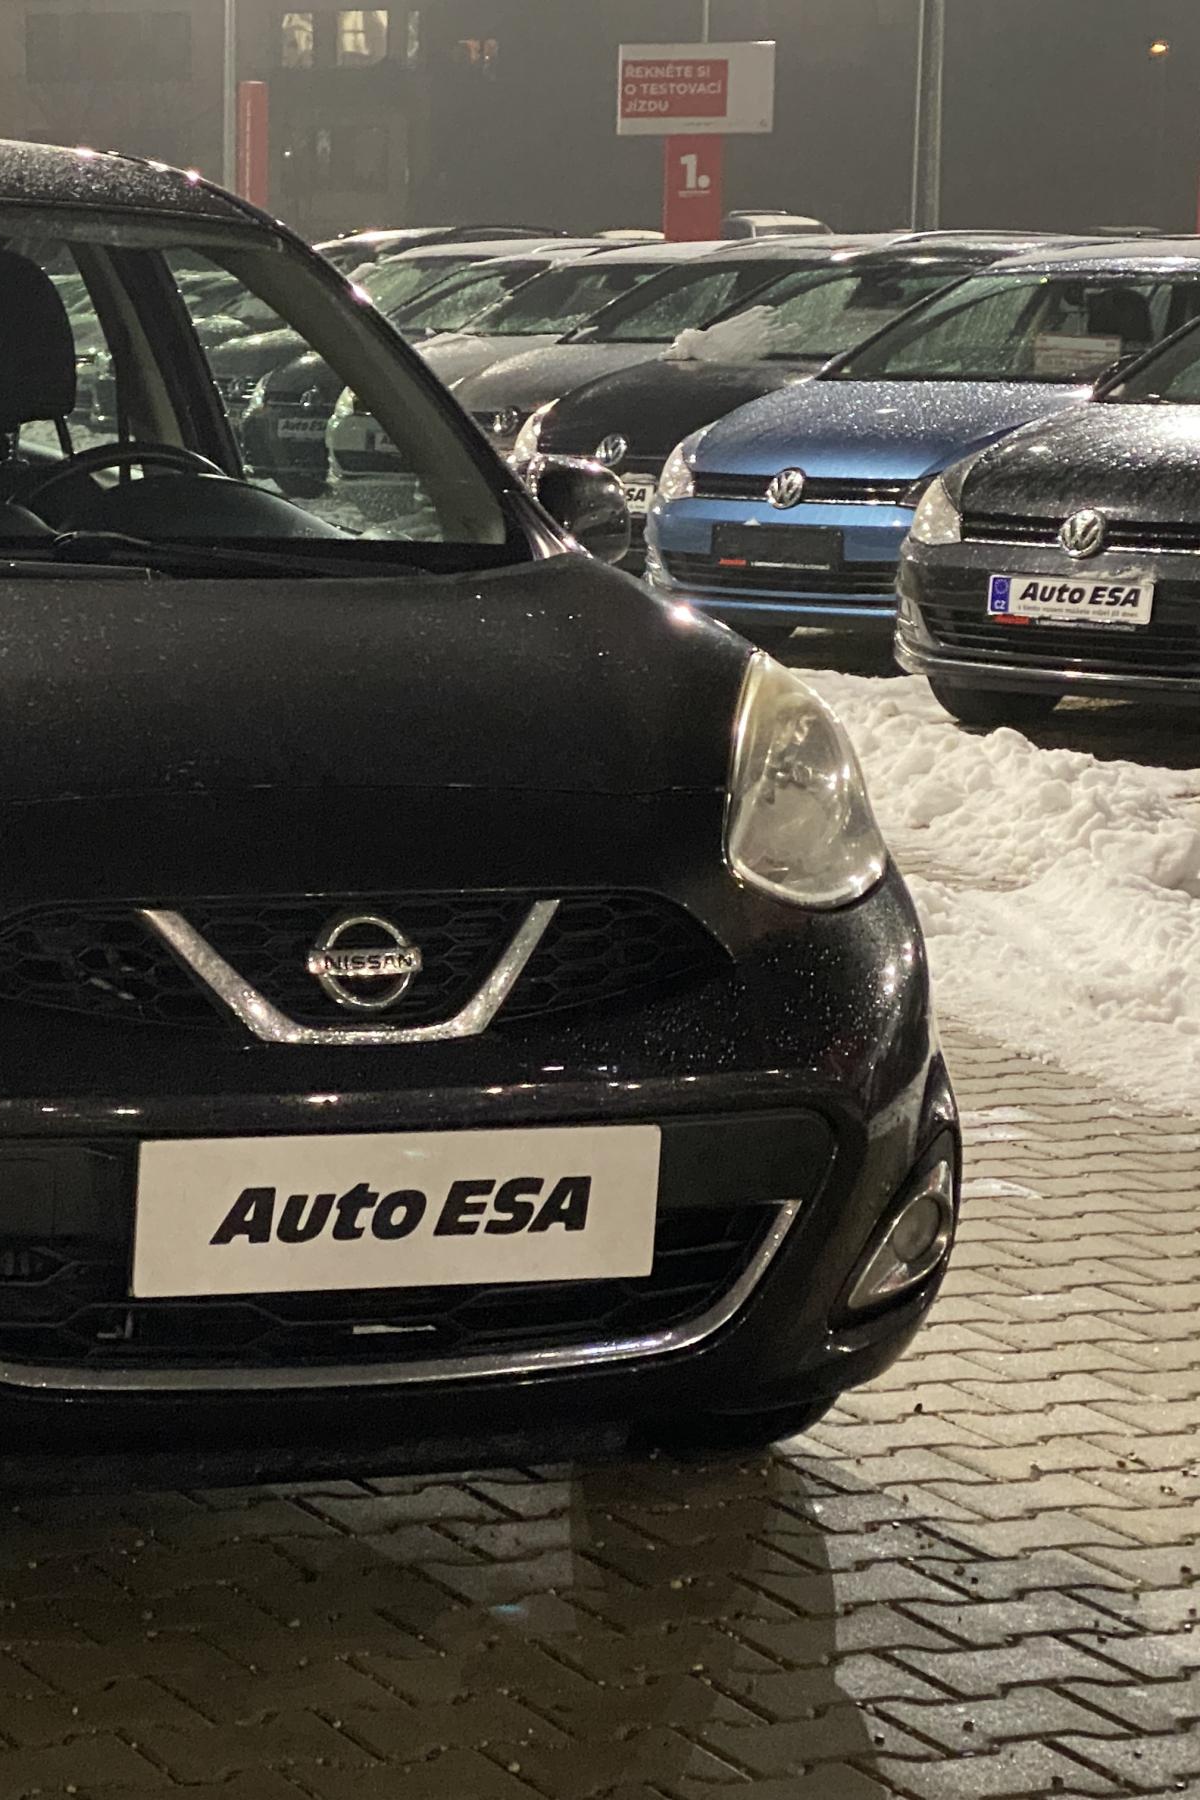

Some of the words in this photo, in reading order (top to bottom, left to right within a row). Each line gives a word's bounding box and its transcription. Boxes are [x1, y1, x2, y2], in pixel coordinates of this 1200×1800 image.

[625, 65, 693, 78] ŘEKNĚTE
[697, 65, 710, 78] SI
[624, 84, 637, 95] O
[641, 81, 721, 95] TESTOVACÍ
[625, 99, 669, 113] JÍZDU
[626, 488, 647, 502] SA
[1019, 582, 1085, 605] Auto
[1088, 586, 1142, 608] ESA
[994, 600, 1006, 610] CZ
[324, 954, 413, 971] NISSAN
[209, 1182, 428, 1245] Auto
[433, 1175, 593, 1237] ESA
